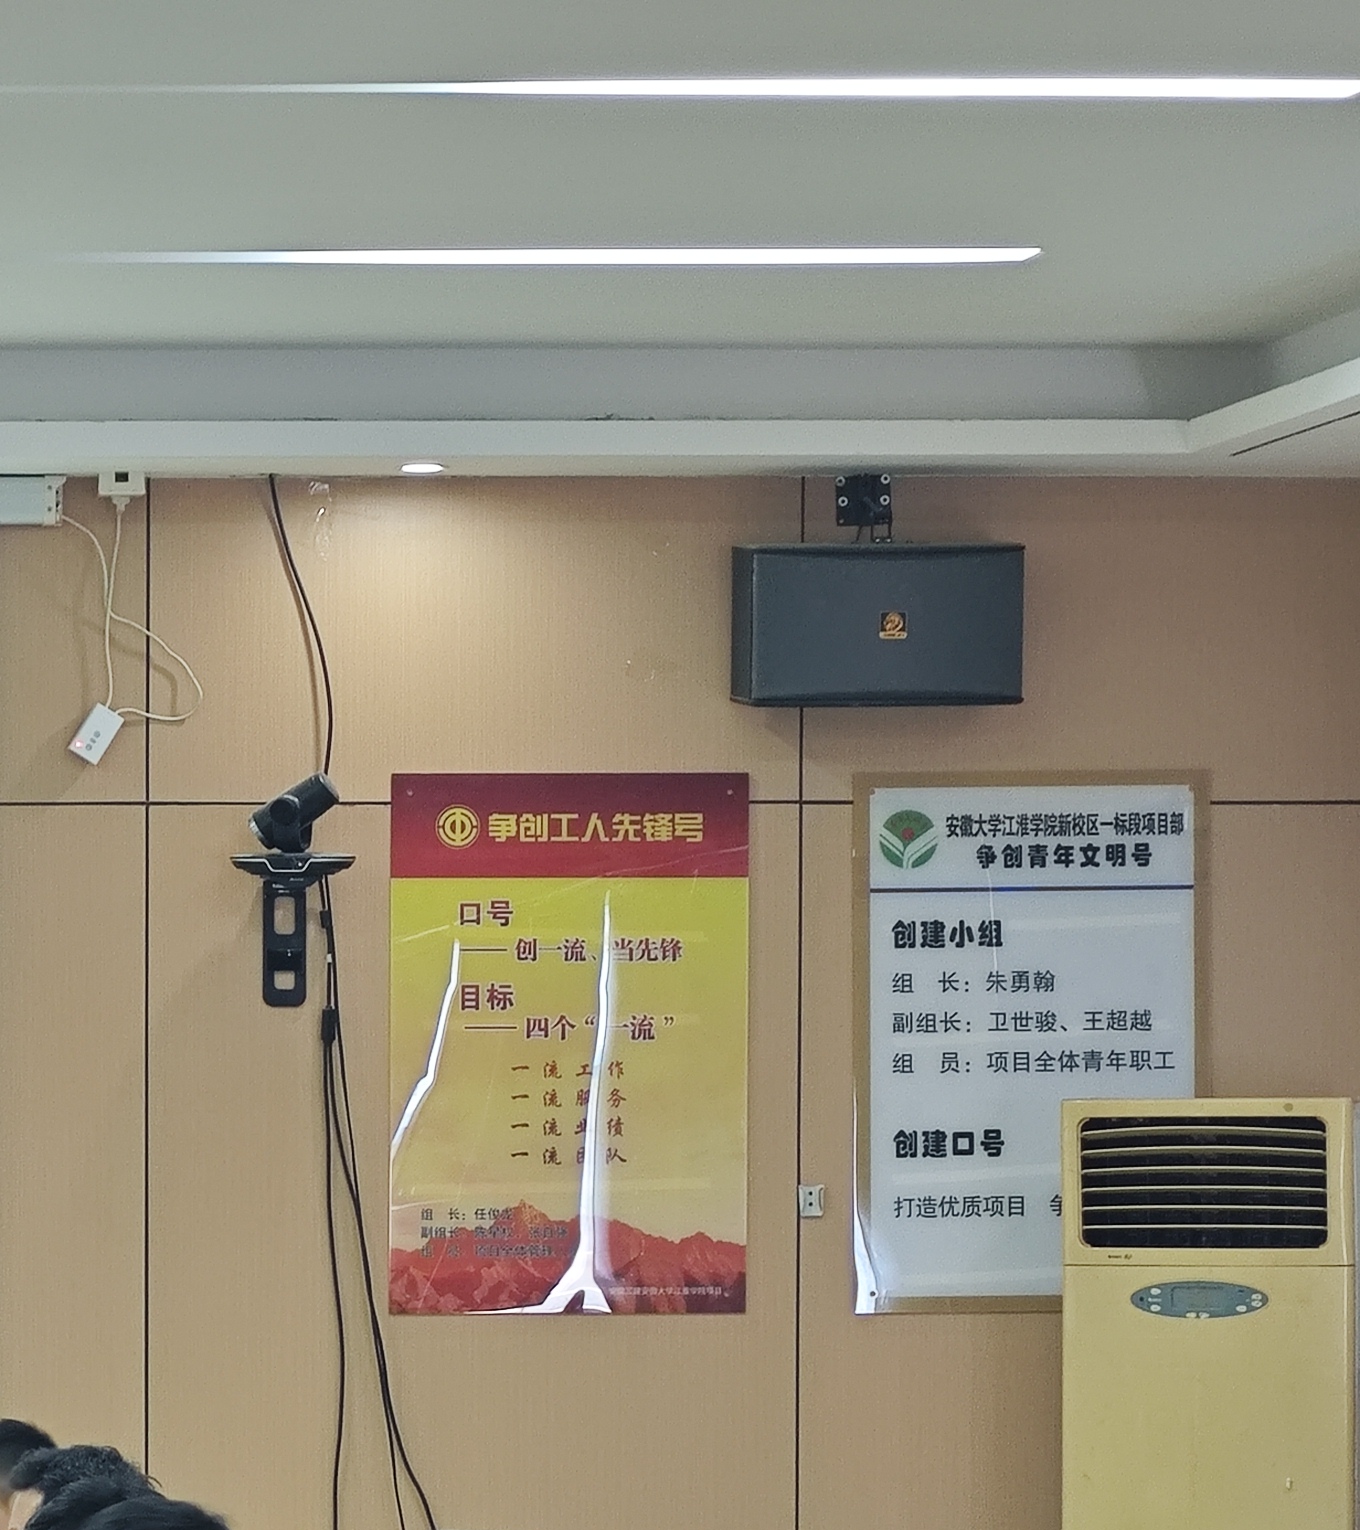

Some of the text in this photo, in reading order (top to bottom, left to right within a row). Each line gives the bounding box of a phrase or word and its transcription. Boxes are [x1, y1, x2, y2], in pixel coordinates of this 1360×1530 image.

[487, 811, 705, 845] 争创工人先锋号
[945, 812, 1185, 838] 安徽大学江淮学院新校区一标段项目部
[976, 842, 1153, 869] 争创青年文明号
[458, 899, 515, 928] 口号
[892, 919, 1004, 949] 创建小组
[459, 983, 515, 1011] 目标
[891, 1009, 1153, 1034] 副组长：卫世骏、王超越
[892, 1128, 1006, 1158] 创建口号
[893, 1194, 1027, 1219] 打造优质项目
